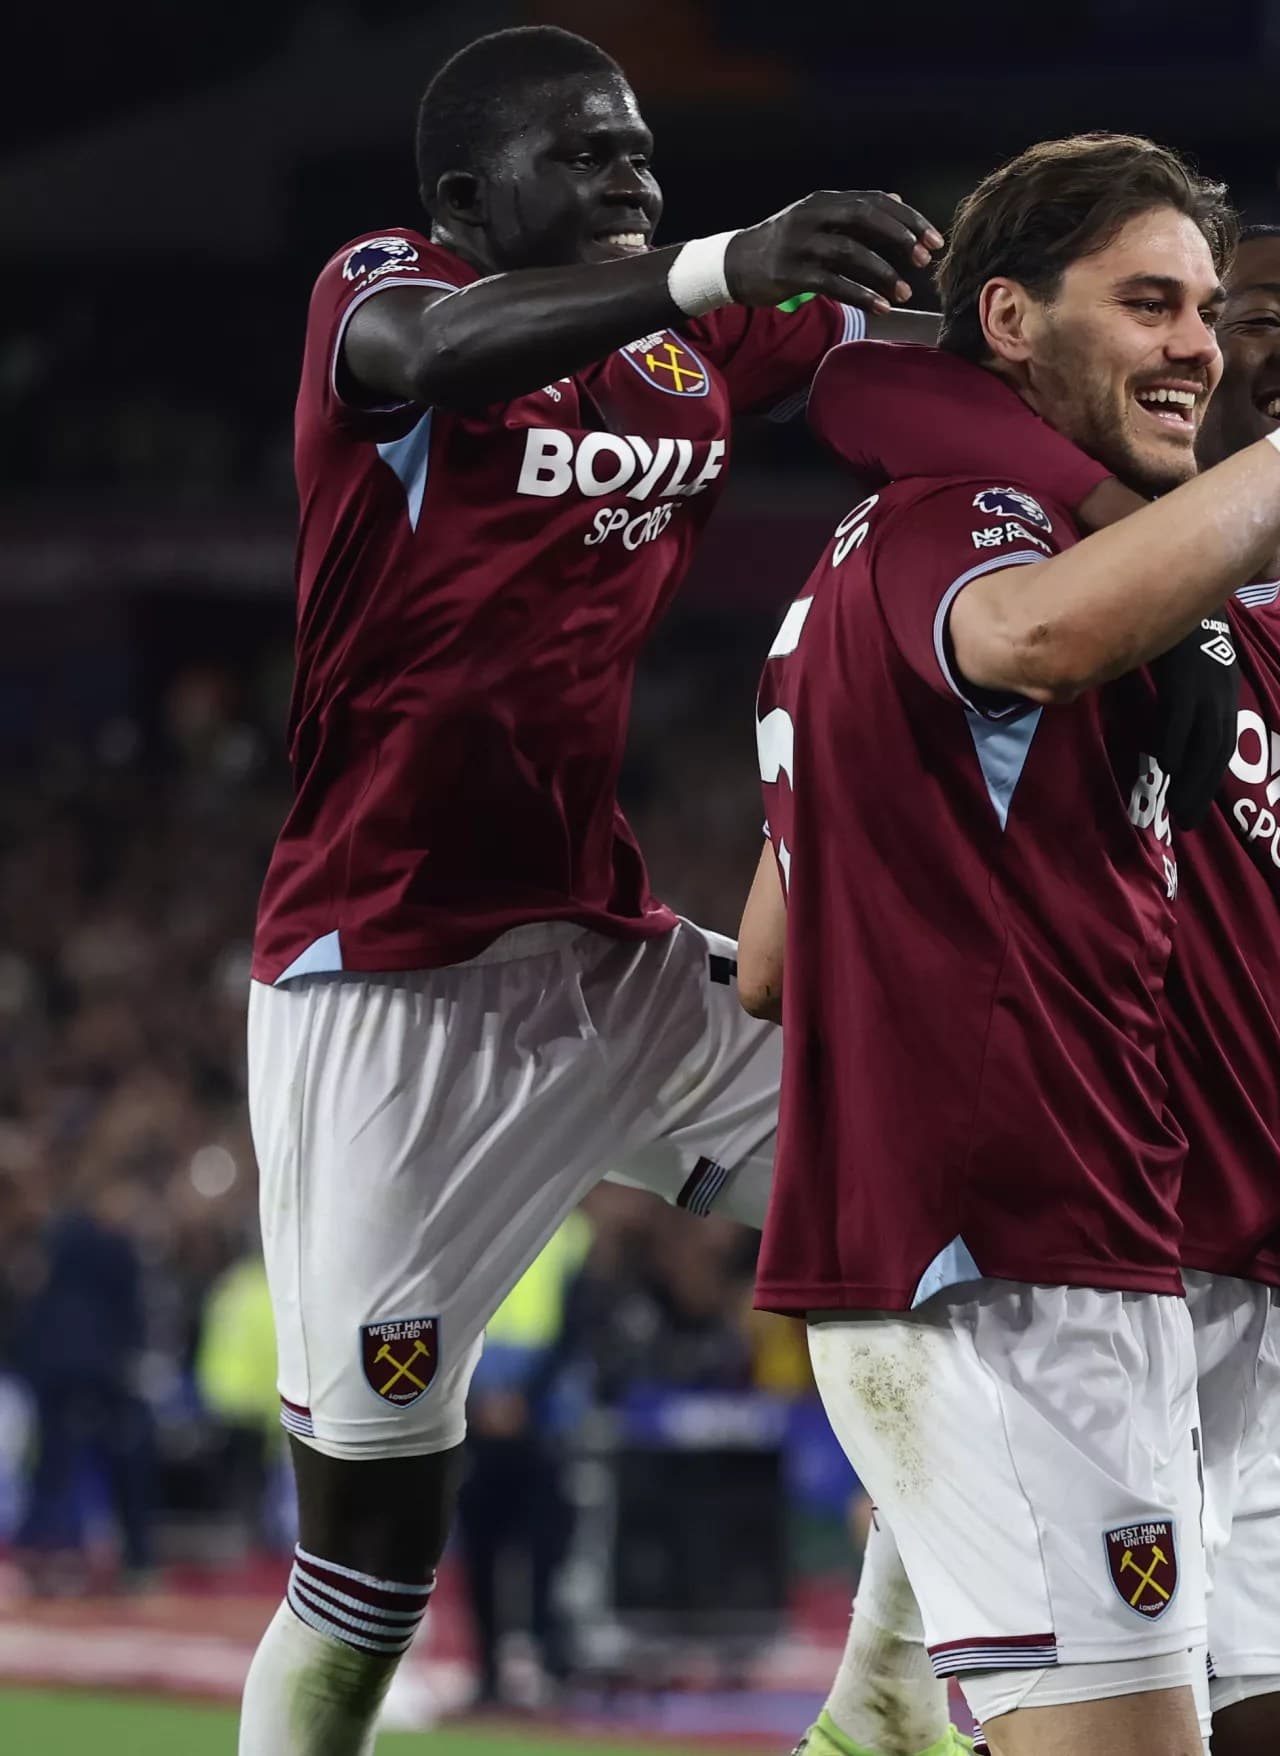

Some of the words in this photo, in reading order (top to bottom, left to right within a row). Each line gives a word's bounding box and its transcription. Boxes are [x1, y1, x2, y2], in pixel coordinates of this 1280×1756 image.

[542, 384, 562, 402] bro
[516, 428, 725, 500] BOYLE
[368, 1323, 403, 1337] WEST
[404, 1320, 433, 1332] HAM
[382, 1329, 421, 1342] UNITED
[388, 1390, 419, 1400] LONDON
[1110, 1526, 1140, 1543] WEST
[1140, 1524, 1167, 1536] HAM
[1123, 1534, 1157, 1548] UNITED
[1139, 1601, 1165, 1612] LONDON
